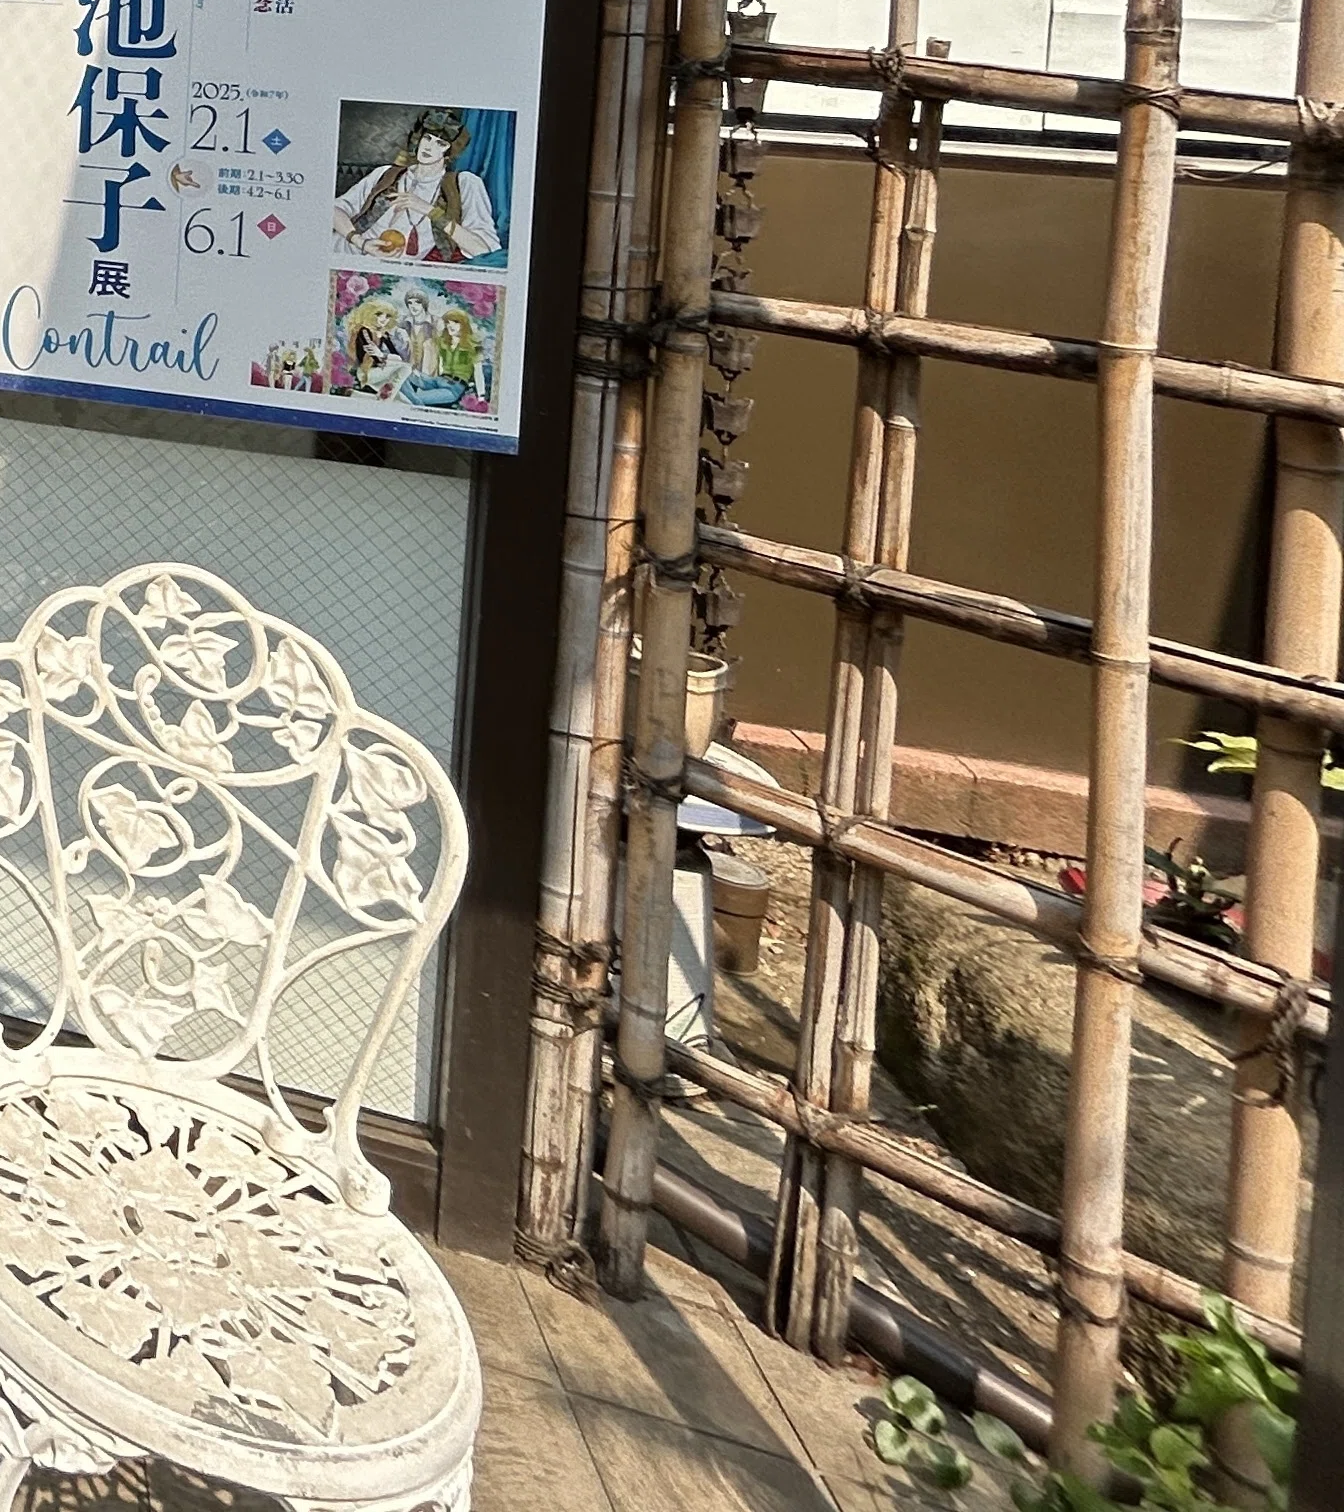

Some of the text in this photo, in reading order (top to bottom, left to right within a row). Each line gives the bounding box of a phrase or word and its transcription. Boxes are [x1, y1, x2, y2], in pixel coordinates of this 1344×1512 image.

[189, 104, 256, 155] 2.1
[184, 207, 251, 258] 6.1
[1, 284, 219, 383] Contrail
